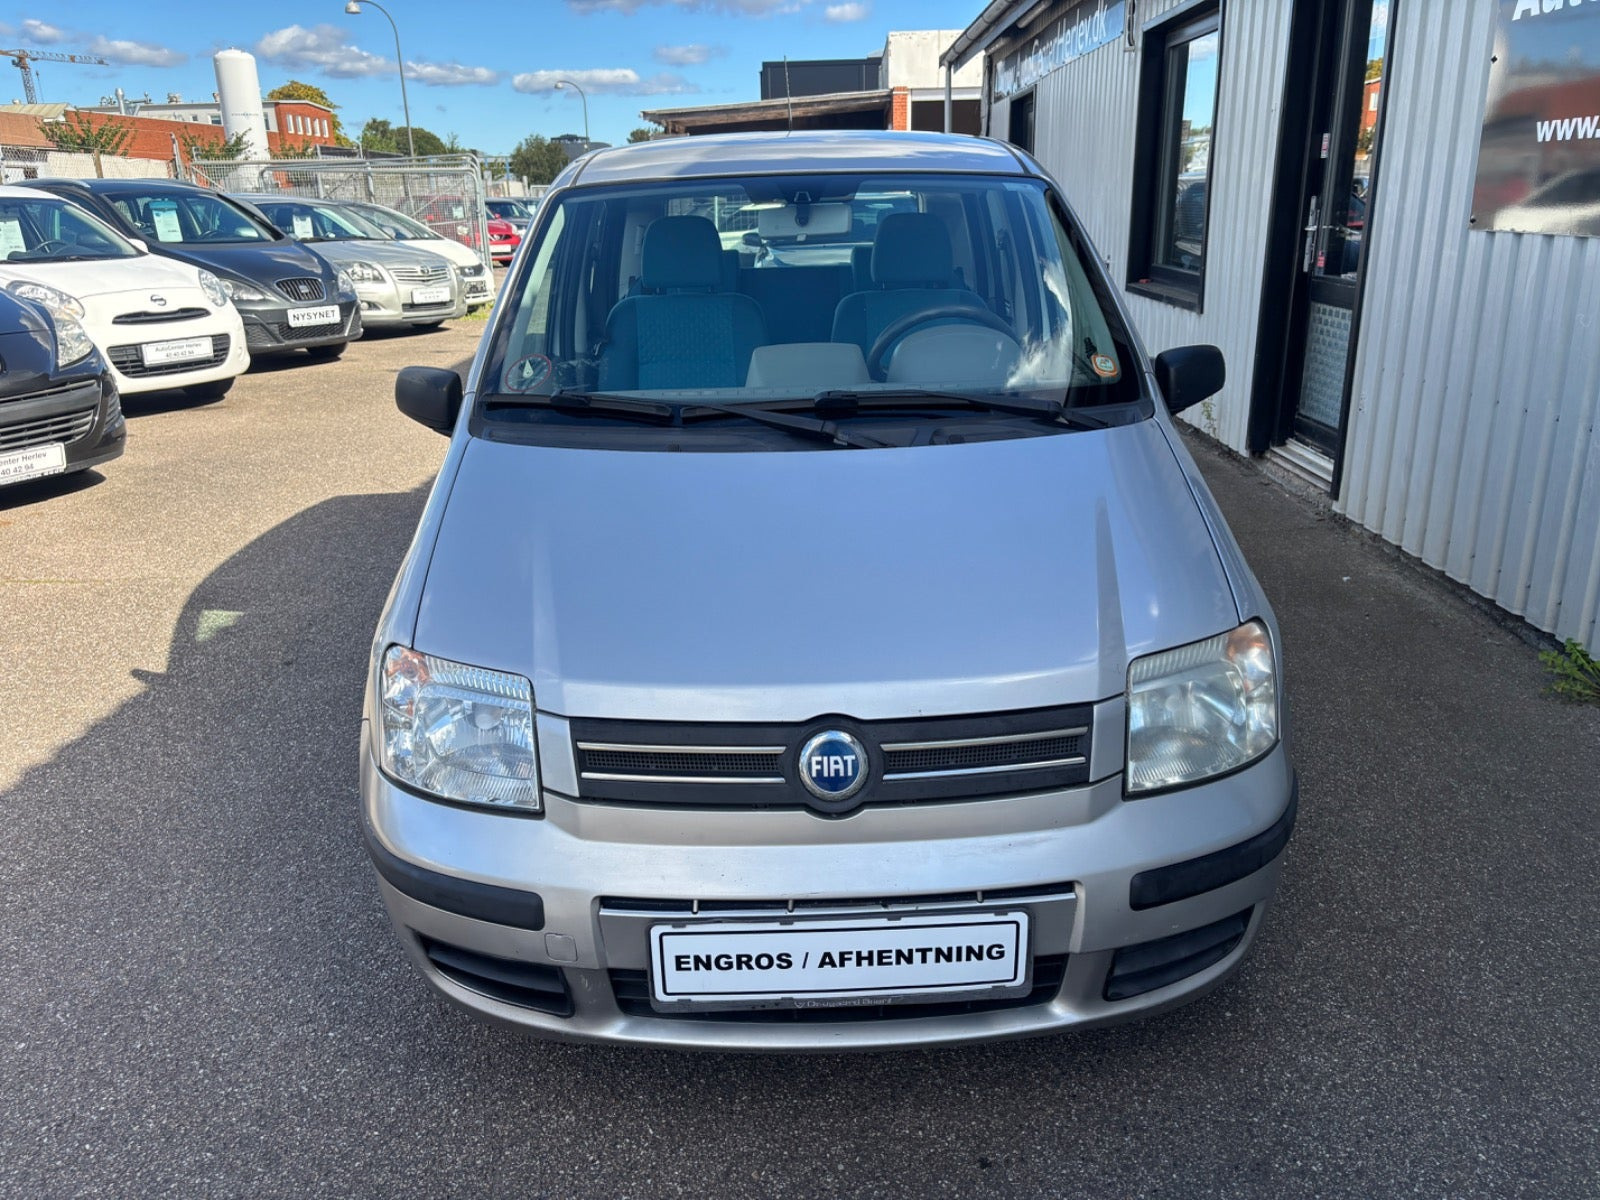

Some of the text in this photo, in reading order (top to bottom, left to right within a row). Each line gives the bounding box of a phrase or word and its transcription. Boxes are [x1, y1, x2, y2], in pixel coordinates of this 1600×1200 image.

[1511, 0, 1600, 21] Au
[292, 310, 336, 321] NYSYNET
[811, 754, 856, 778] FIAT
[675, 952, 793, 972] ENGROS
[818, 943, 1006, 969] AFHENTNING
